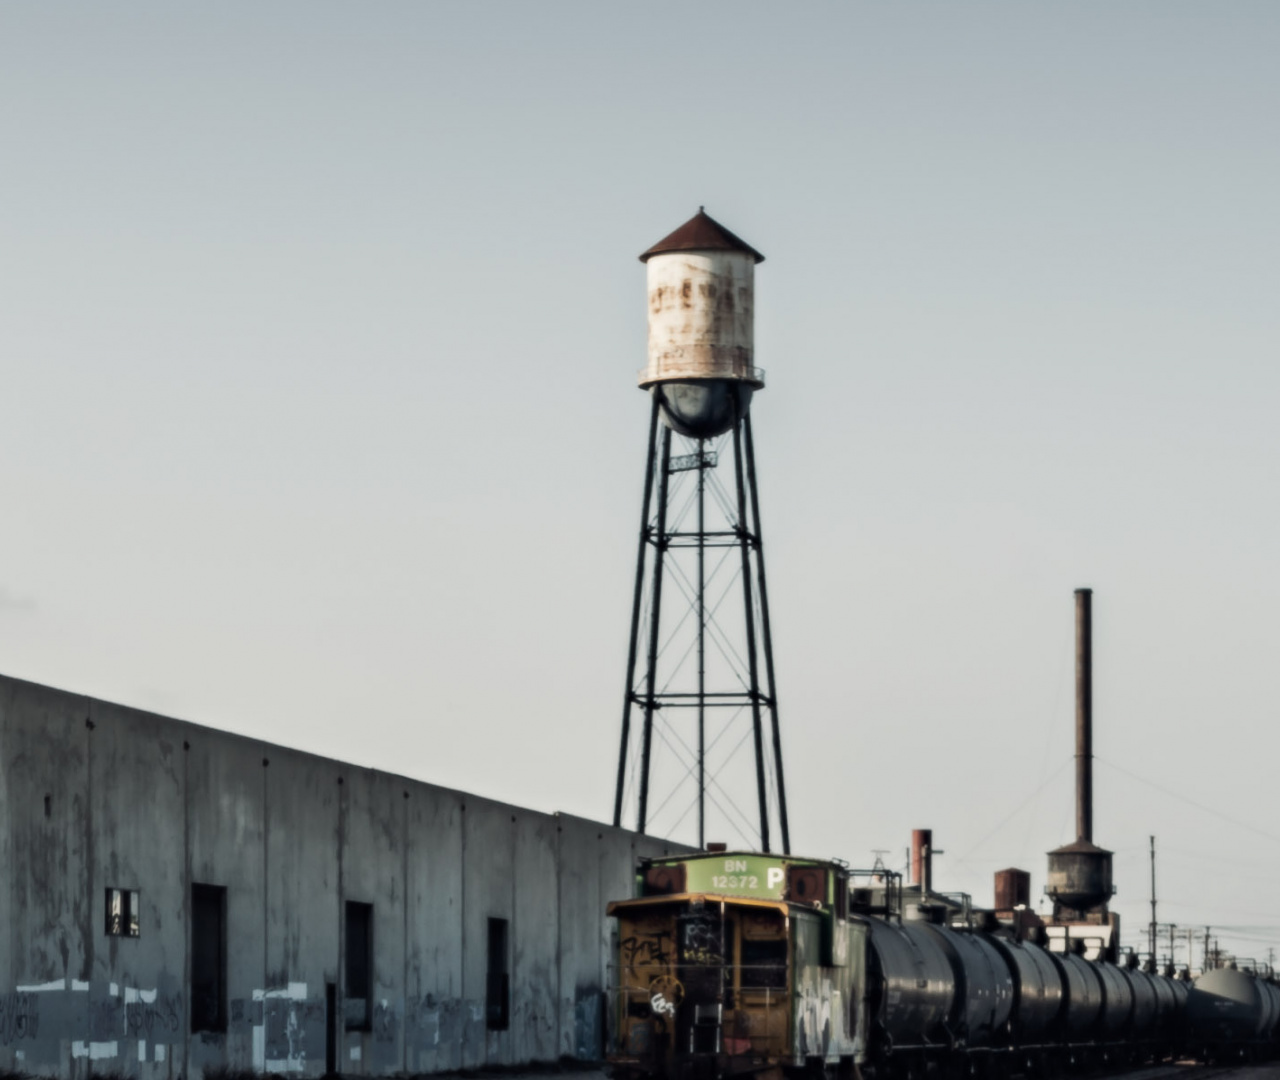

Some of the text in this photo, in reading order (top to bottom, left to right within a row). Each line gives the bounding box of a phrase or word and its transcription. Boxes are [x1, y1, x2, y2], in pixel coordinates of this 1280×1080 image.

[724, 860, 747, 872] BN
[712, 875, 758, 889] 12372
[767, 867, 784, 889] P
